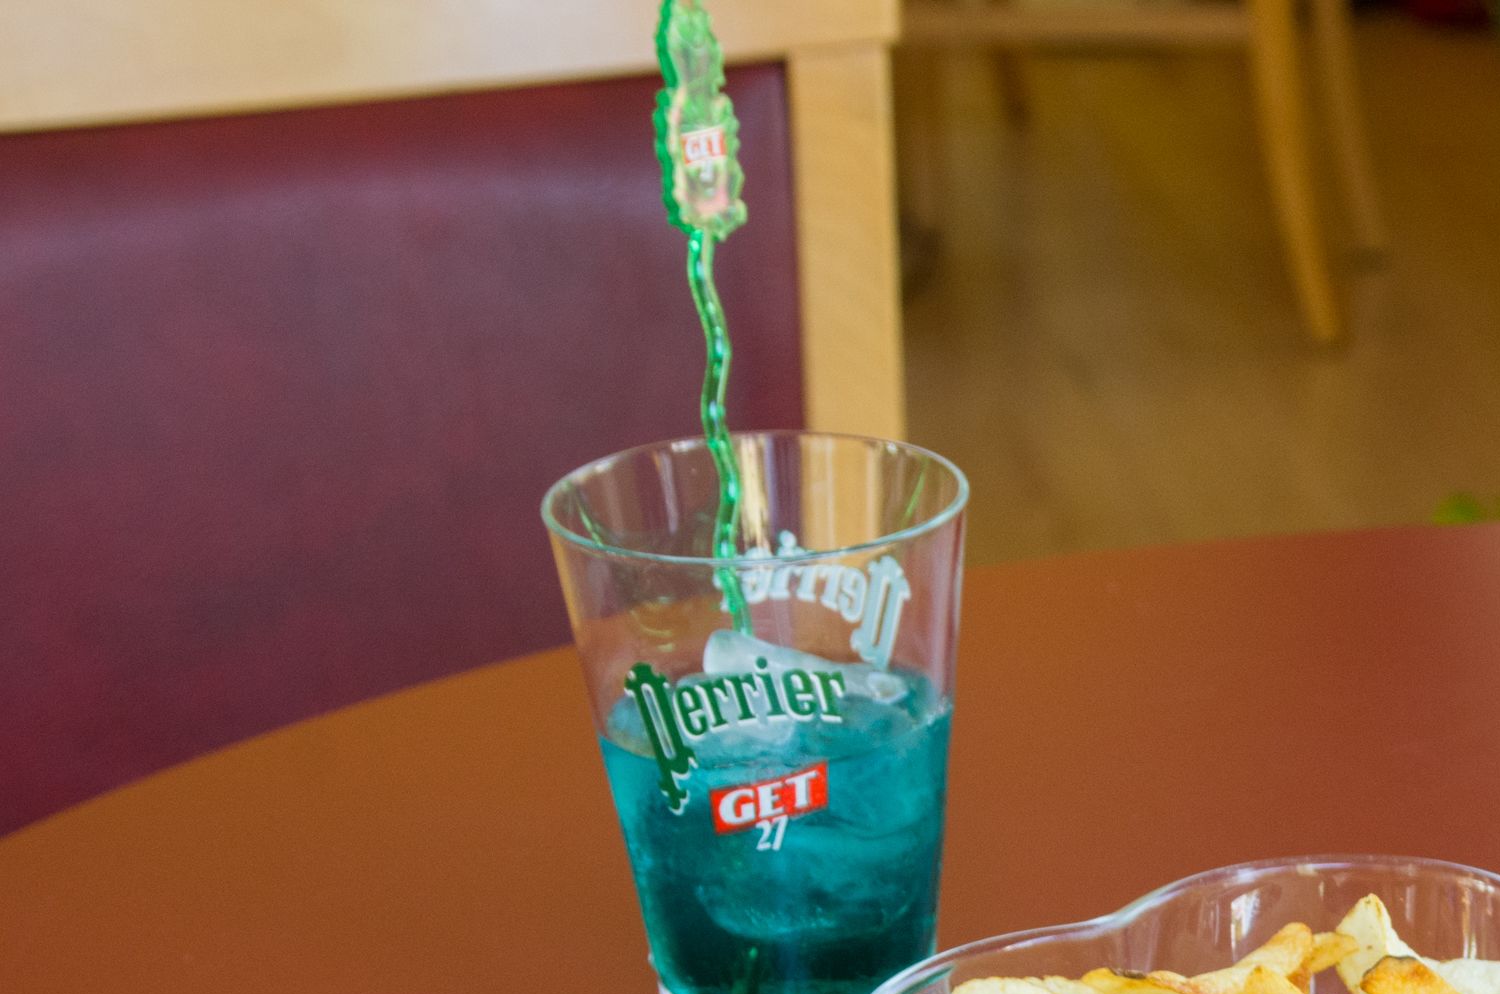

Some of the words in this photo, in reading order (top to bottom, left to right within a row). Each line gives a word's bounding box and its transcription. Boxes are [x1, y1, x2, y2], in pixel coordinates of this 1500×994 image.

[624, 656, 846, 816] Perrier
[718, 770, 819, 825] GET
[755, 815, 788, 851] 27
